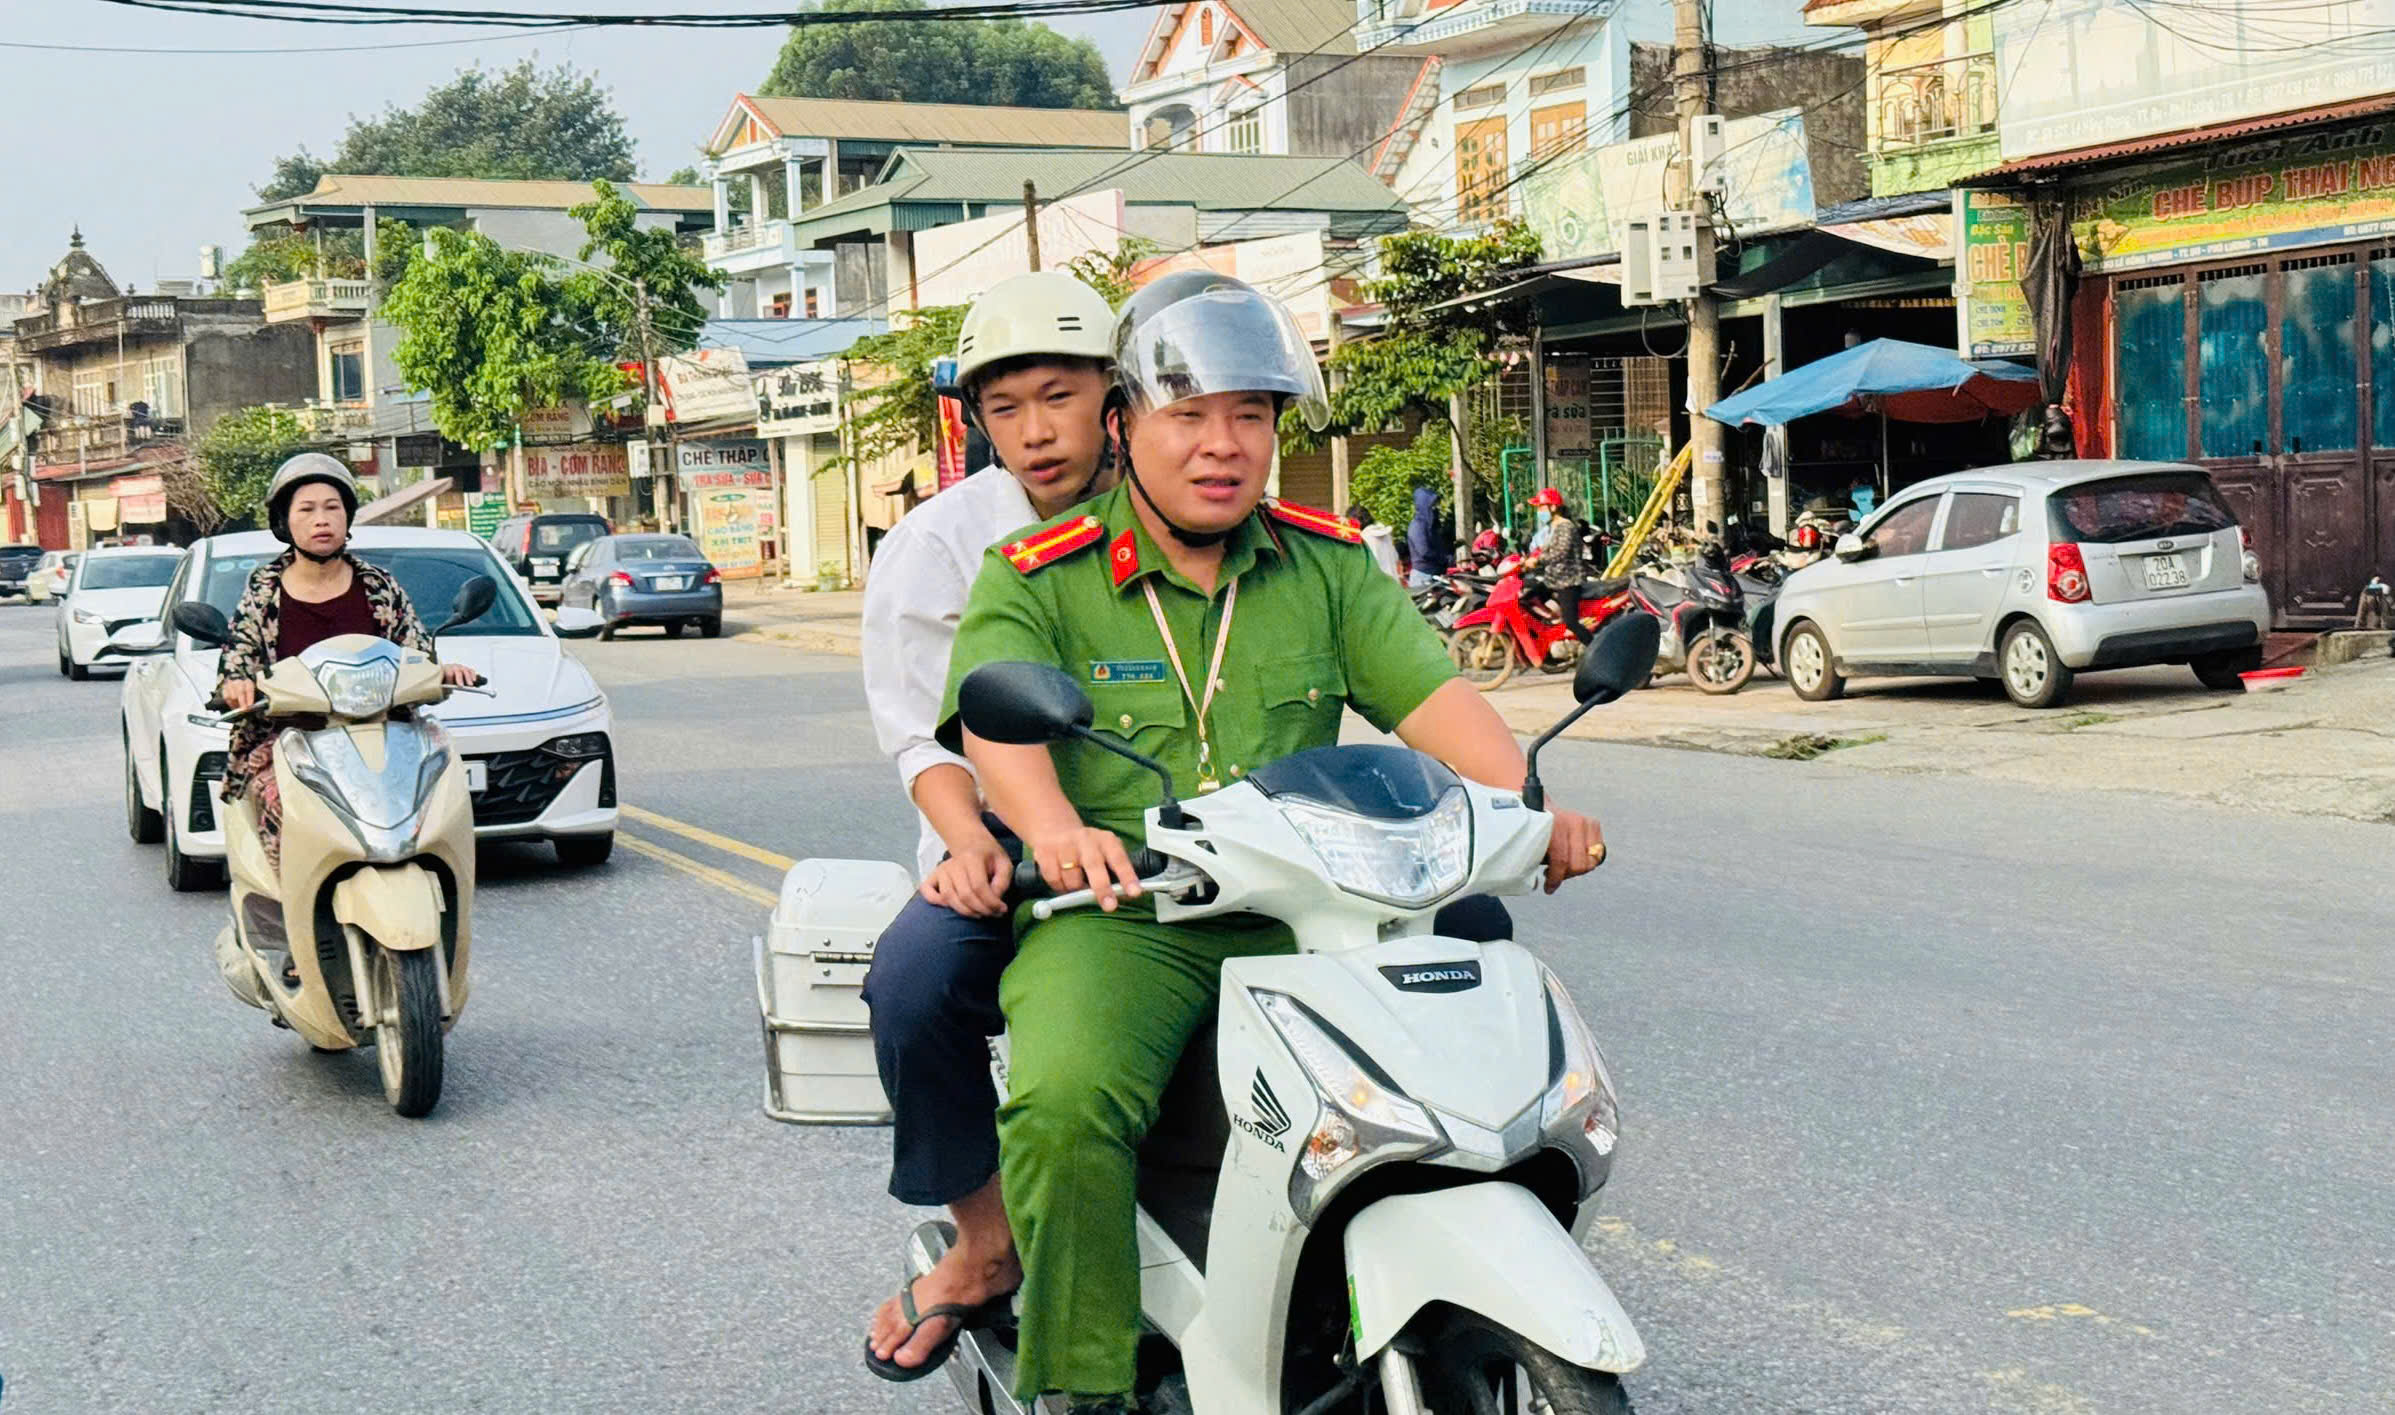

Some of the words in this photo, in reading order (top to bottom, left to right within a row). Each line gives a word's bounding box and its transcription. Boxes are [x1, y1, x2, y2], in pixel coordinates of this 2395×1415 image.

[2152, 556, 2175, 571] 20A
[1402, 970, 1476, 985] HONDA
[1233, 1113, 1286, 1154] HONDA
